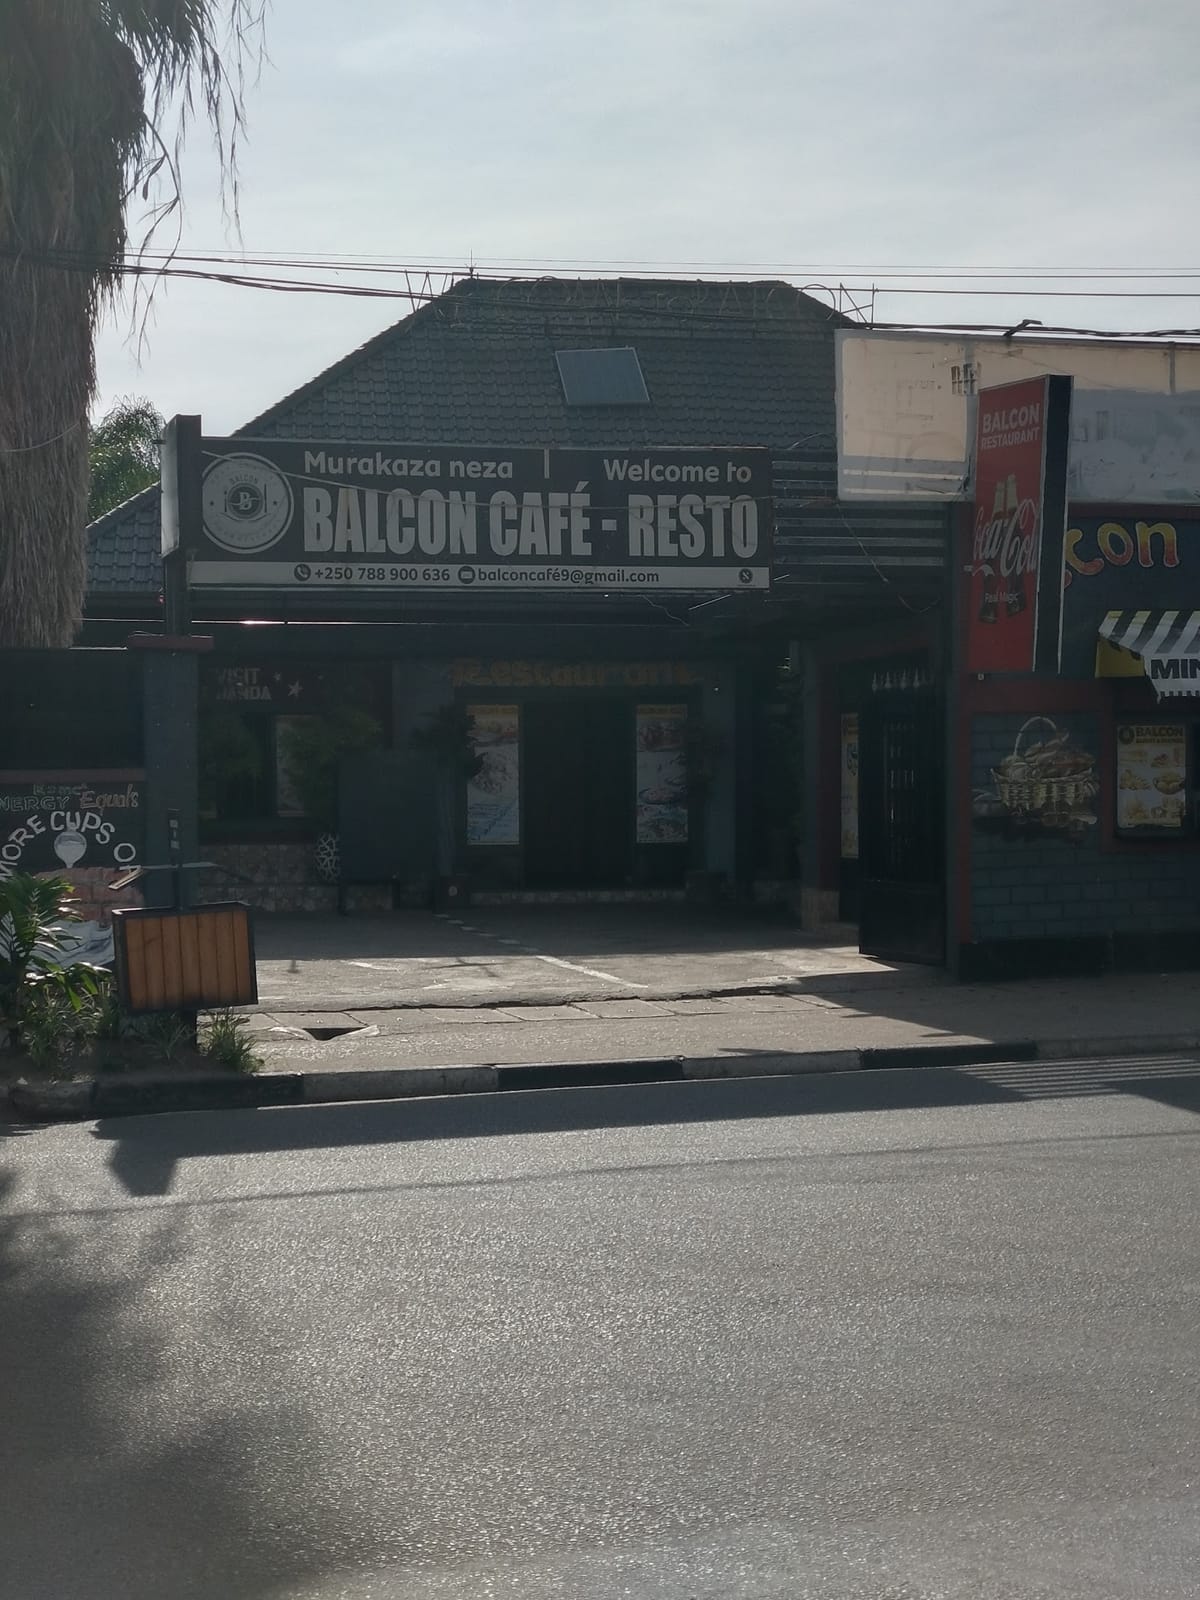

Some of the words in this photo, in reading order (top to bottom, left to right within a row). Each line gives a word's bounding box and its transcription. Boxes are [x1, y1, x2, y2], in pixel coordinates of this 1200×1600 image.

[983, 403, 1040, 433] BALCON
[981, 427, 1040, 449] RESTAURANT
[304, 451, 441, 477] Murakaza
[449, 461, 513, 479] neza
[603, 459, 720, 482] Welcome
[727, 462, 752, 482] to
[303, 487, 477, 555] BALCON
[489, 481, 592, 556] CAFÉ
[628, 494, 758, 558] RESTO
[315, 567, 353, 580] +250
[358, 568, 386, 580] 788
[390, 568, 418, 581] 900
[422, 568, 451, 581] 636
[478, 568, 659, 584] balconcafé9@gmail.com
[1135, 727, 1184, 737] BALCON
[49, 811, 116, 845] CUPS
